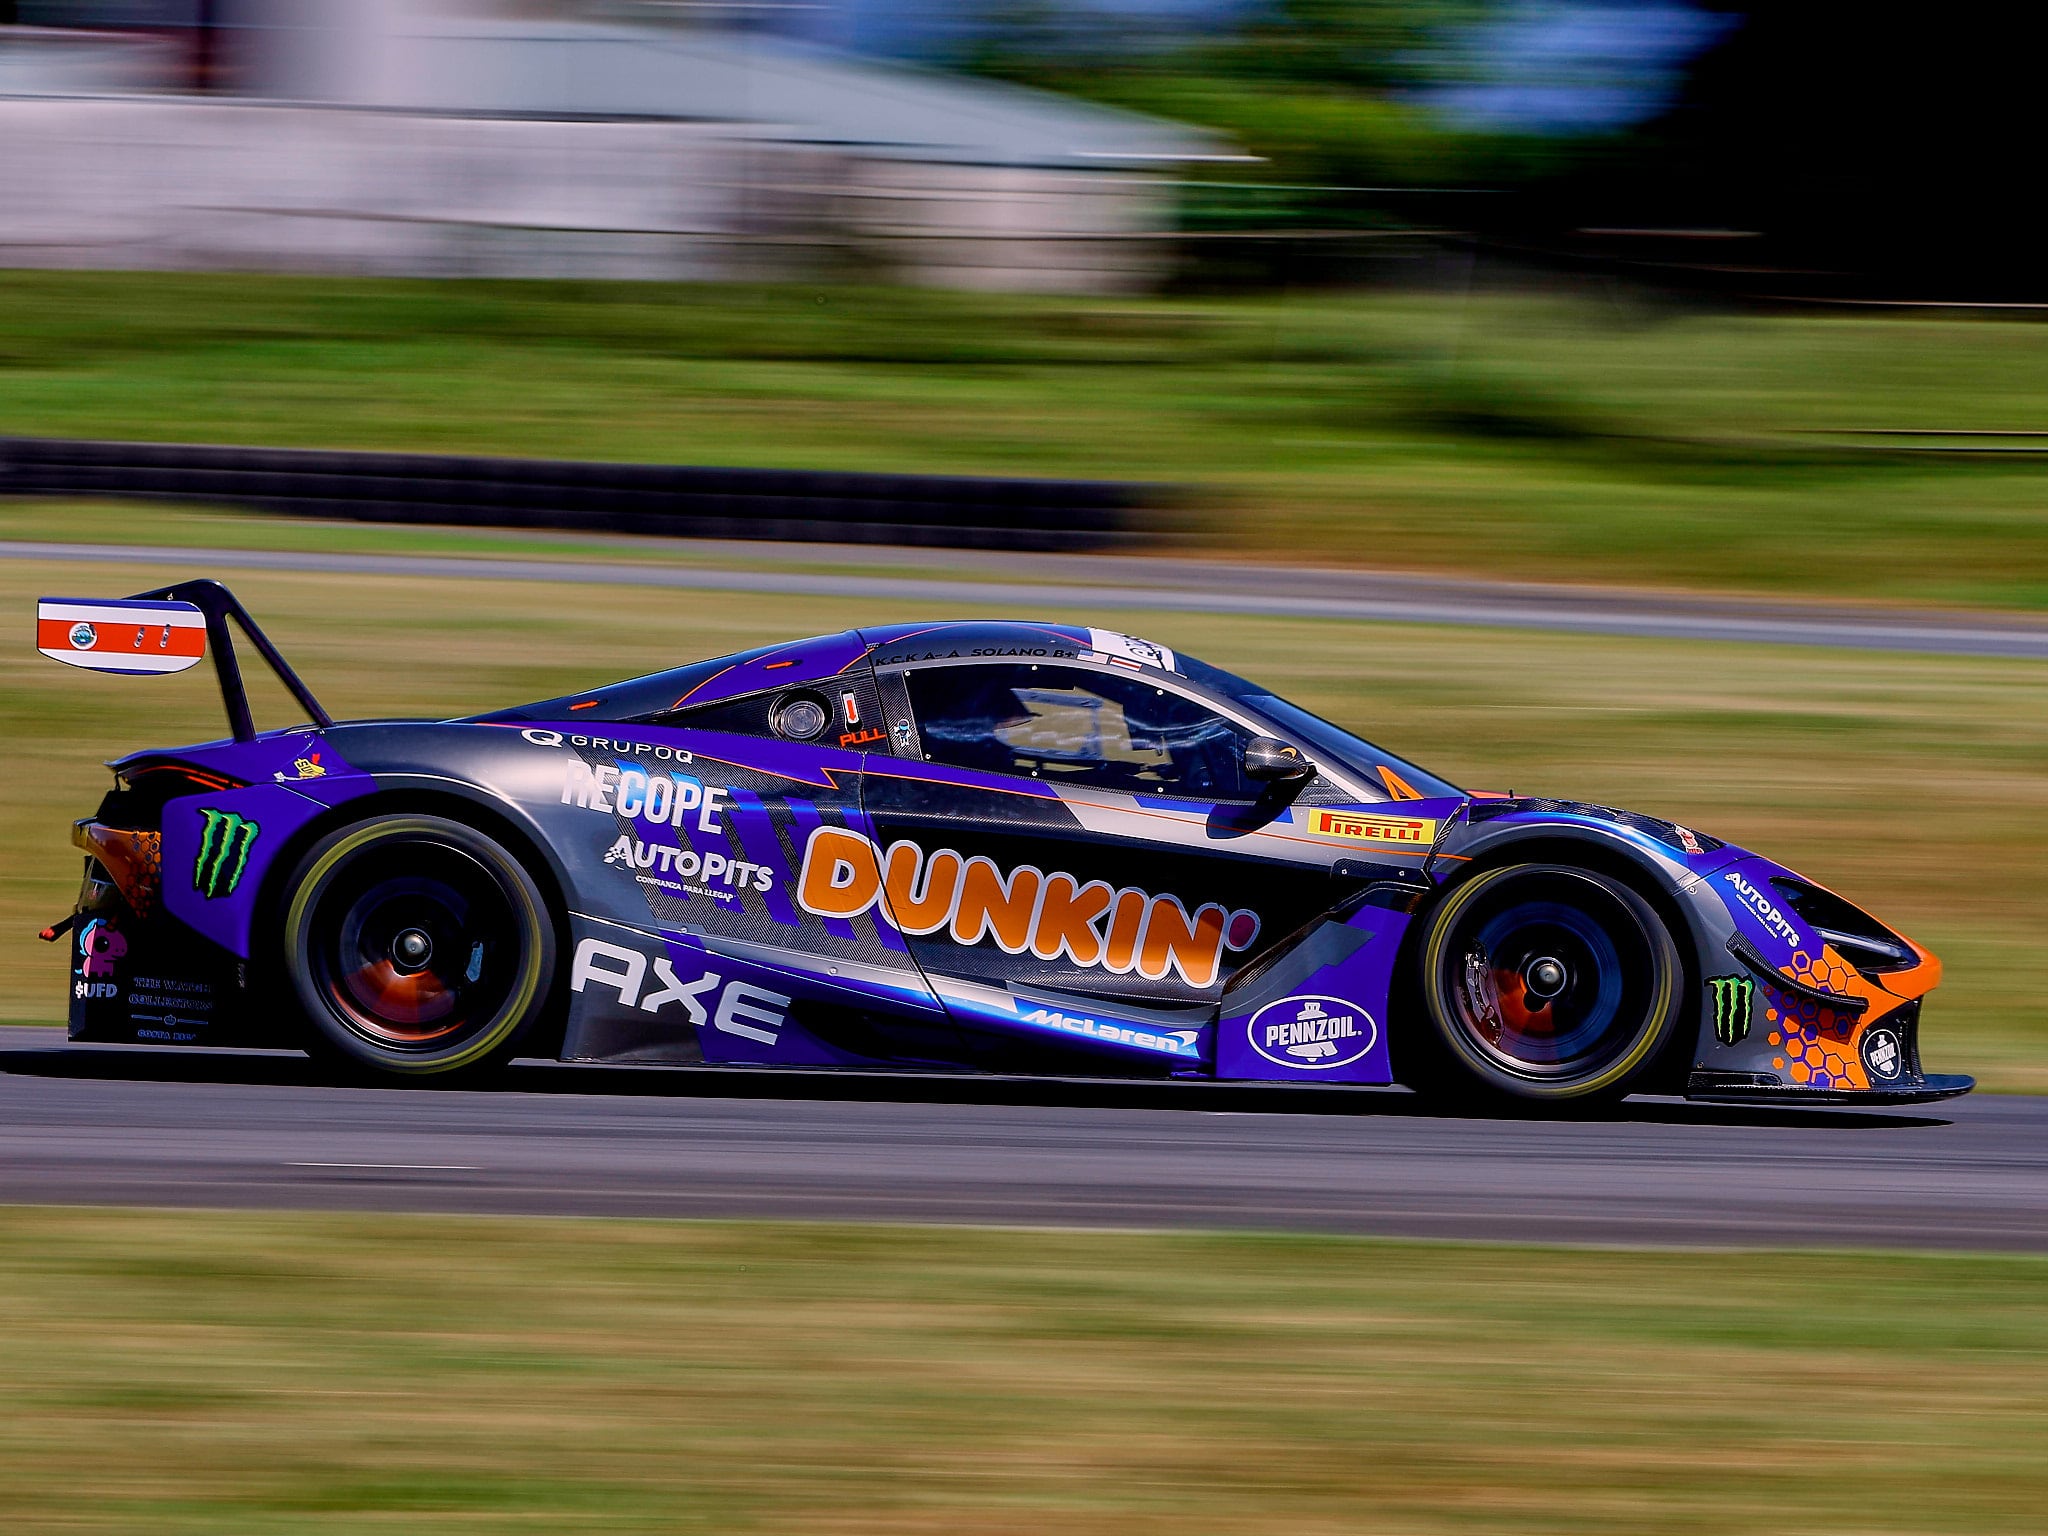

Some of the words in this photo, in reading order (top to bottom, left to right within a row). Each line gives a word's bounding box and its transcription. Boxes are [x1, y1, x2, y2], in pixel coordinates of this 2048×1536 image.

[971, 643, 1047, 657] SOLANO
[1053, 649, 1074, 658] B+
[840, 728, 886, 747] PULL
[561, 759, 728, 834] RECOPE
[1320, 813, 1423, 841] PIRELLI
[603, 835, 774, 892] AUTOPITS
[636, 875, 682, 891] CONFIANZA
[683, 885, 703, 895] PARA
[799, 826, 1261, 989] DUNKIN'
[1725, 873, 1801, 948] AUTOPITS
[571, 938, 791, 1045] AXE
[1020, 1010, 1178, 1052] McLaren
